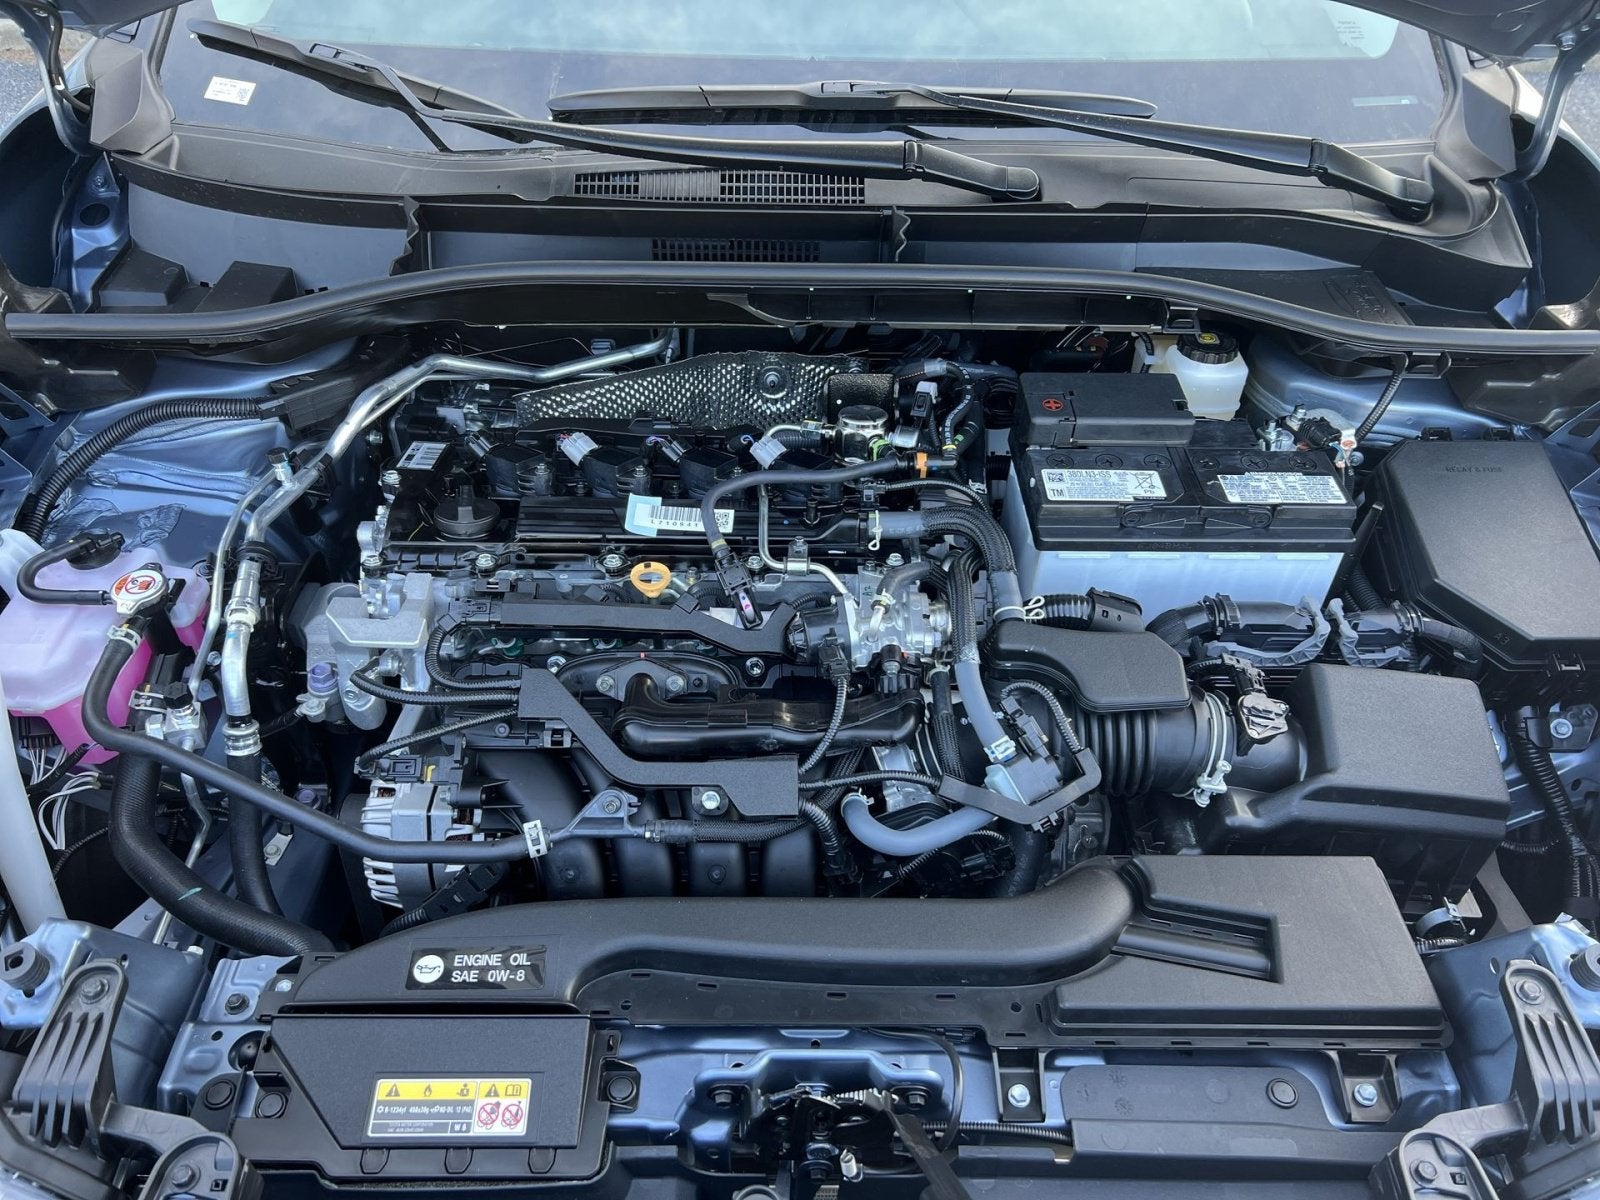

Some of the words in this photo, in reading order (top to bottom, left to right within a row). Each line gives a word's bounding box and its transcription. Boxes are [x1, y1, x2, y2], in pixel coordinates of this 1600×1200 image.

[1050, 488, 1065, 498] TM
[454, 954, 502, 966] ENGINE
[510, 953, 531, 966] OIL
[451, 970, 479, 983] SAE
[487, 969, 526, 983] 0W-8
